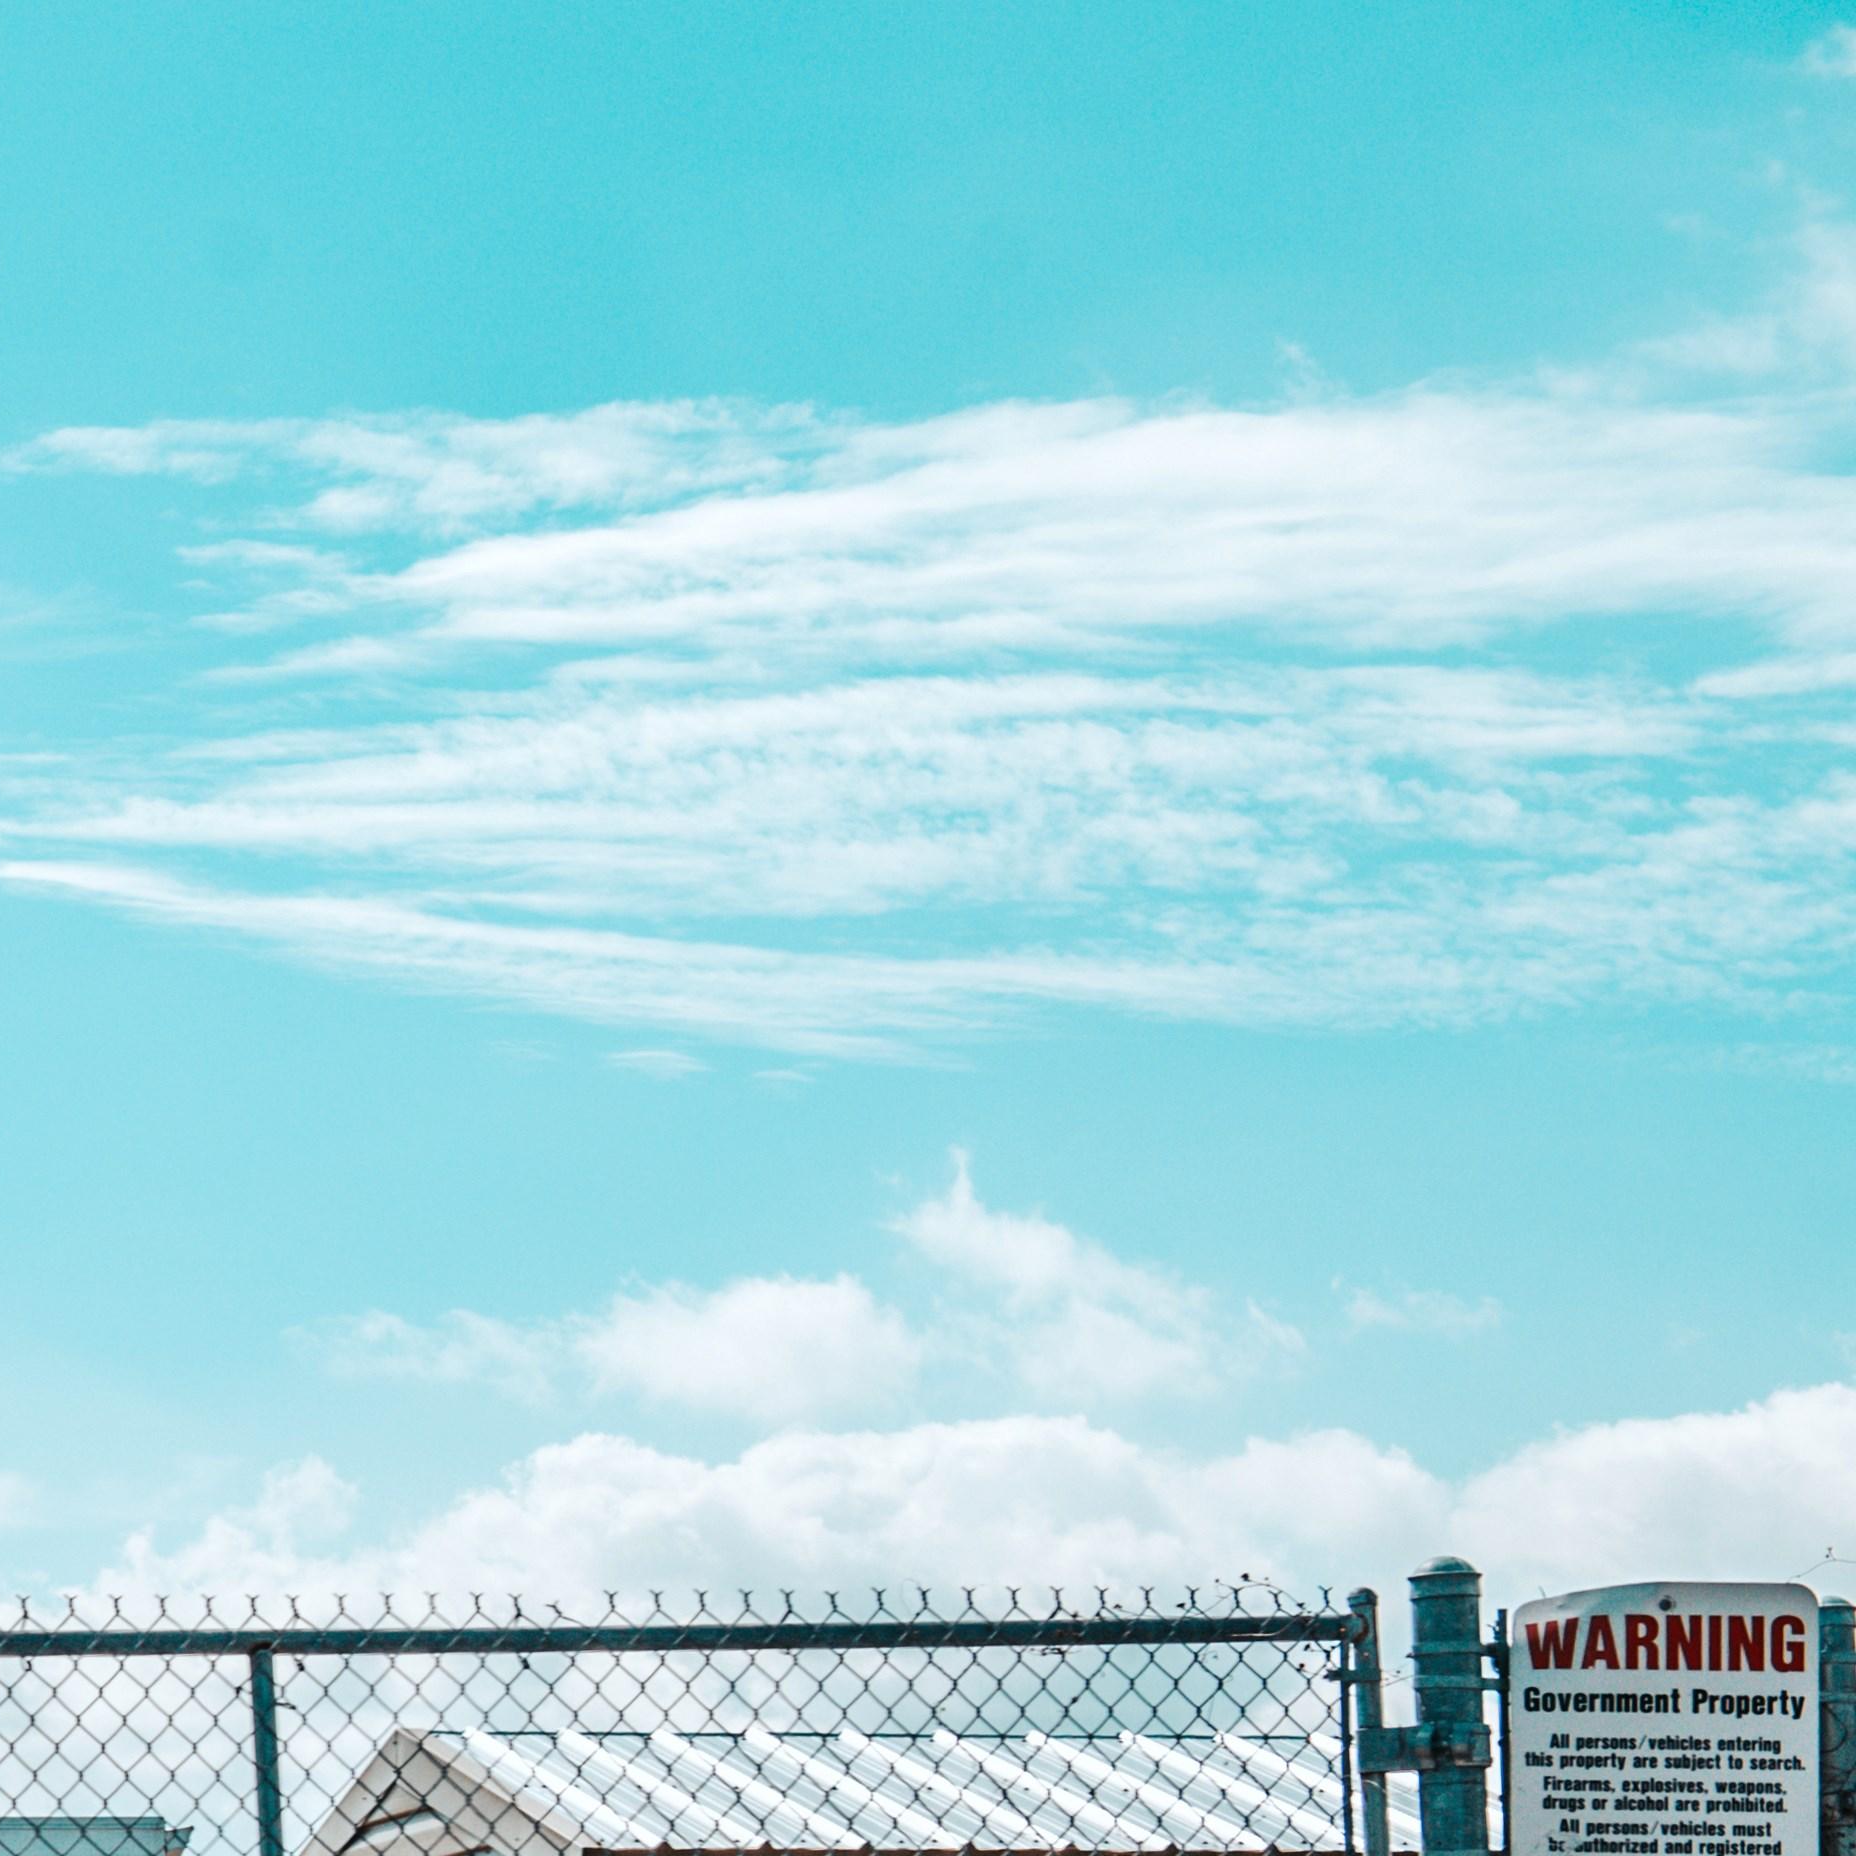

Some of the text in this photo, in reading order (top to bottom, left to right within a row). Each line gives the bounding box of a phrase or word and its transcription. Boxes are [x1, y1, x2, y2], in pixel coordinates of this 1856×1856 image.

[1525, 1614, 1805, 1672] WARNING
[1524, 1687, 1806, 1719] Government Property
[1550, 1733, 1570, 1749] All
[1717, 1736, 1781, 1754] entering
[1524, 1752, 1806, 1771] this property are subject to search.
[1542, 1795, 1788, 1814] drugs or alcohol are prohibited.
[1559, 1819, 1580, 1834] All
[1732, 1822, 1772, 1837] must
[1664, 1840, 1692, 1854] and
[1699, 1840, 1782, 1856] registered
